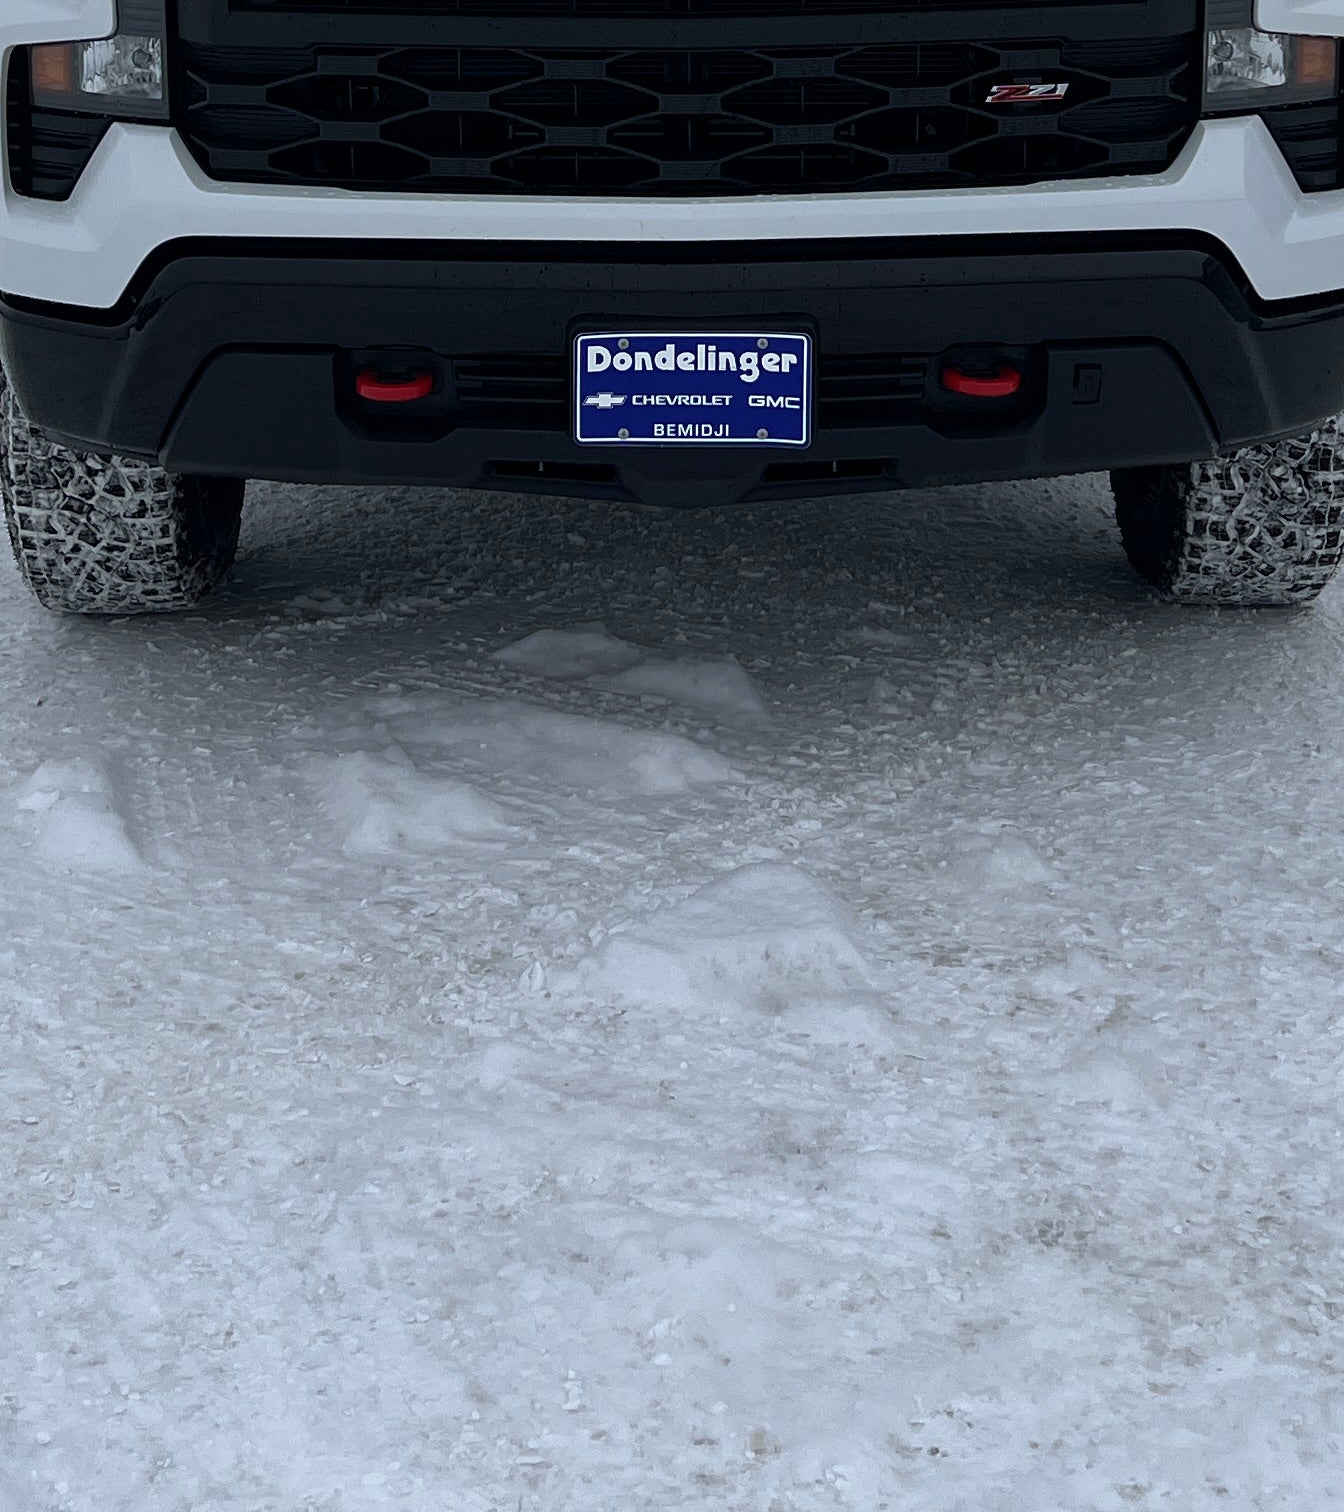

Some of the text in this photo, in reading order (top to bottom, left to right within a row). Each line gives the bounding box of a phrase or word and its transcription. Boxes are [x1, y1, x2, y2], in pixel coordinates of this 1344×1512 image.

[985, 83, 1069, 103] Z71
[587, 344, 798, 383] Dondelinger
[632, 394, 800, 409] CHEVROLET GMC
[654, 424, 730, 437] BEMIDJI
